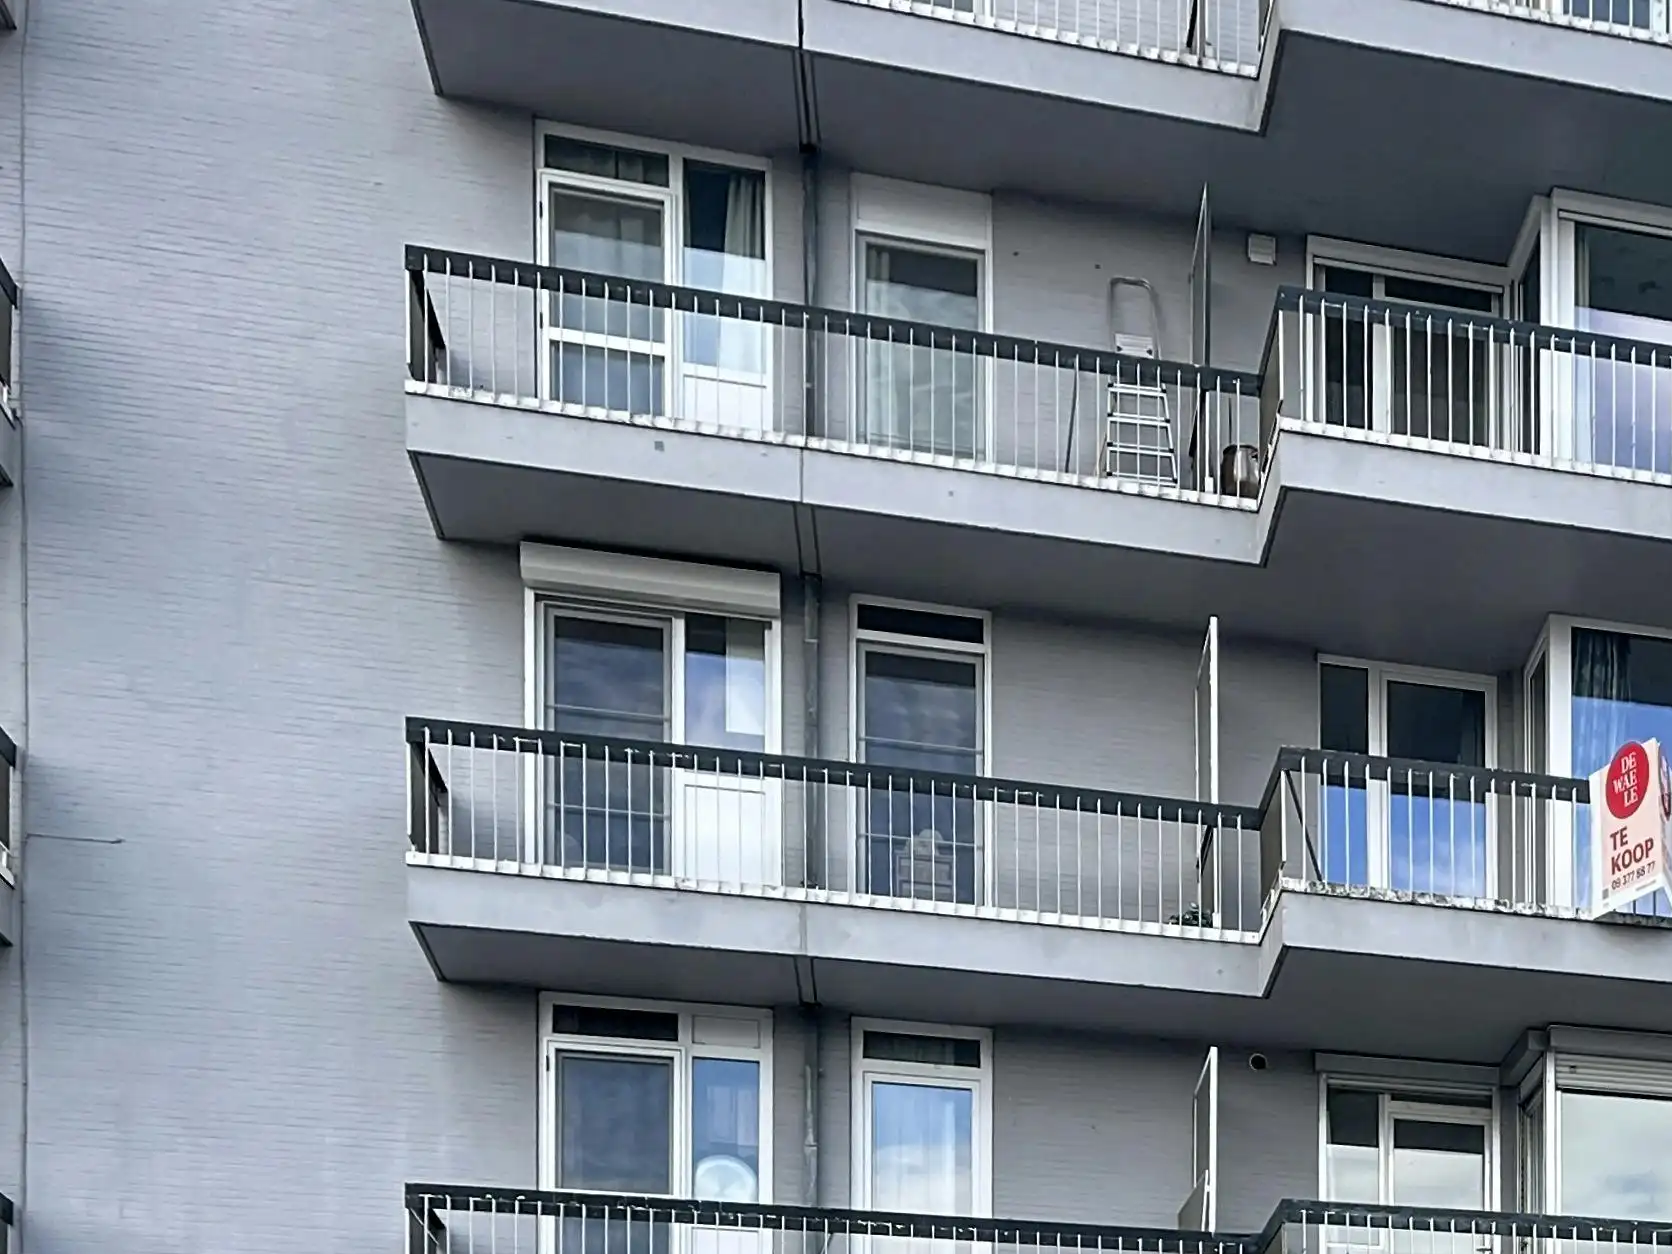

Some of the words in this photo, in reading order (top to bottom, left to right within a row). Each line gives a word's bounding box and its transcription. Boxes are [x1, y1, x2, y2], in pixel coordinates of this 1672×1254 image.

[1620, 751, 1636, 774] DE
[1624, 786, 1638, 807] LE
[1610, 826, 1628, 850] TE
[1611, 837, 1654, 876] KOOP
